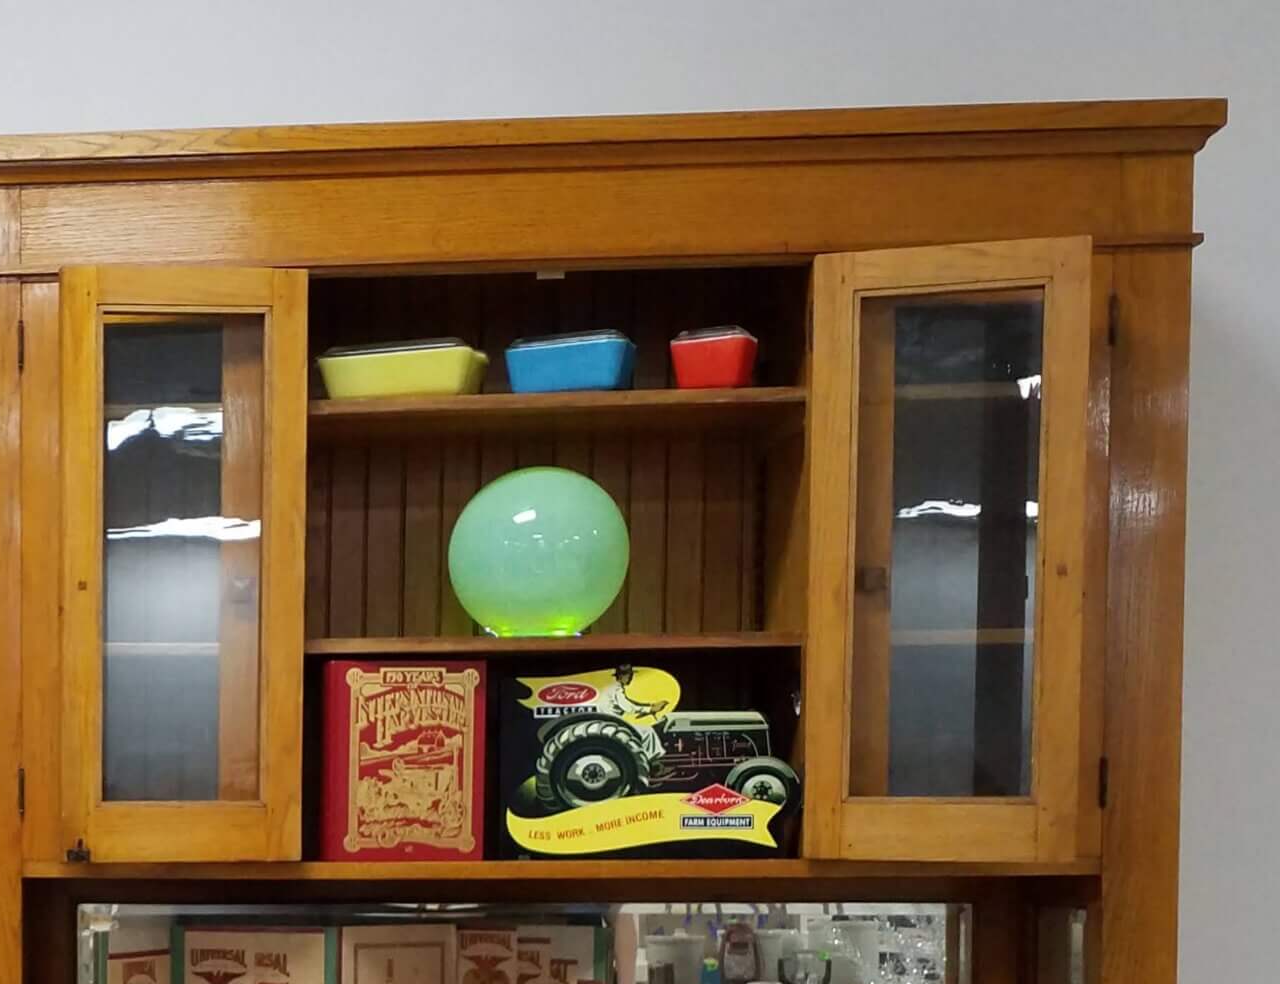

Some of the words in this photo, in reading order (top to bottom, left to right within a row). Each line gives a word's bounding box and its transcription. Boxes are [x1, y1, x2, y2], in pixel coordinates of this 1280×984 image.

[405, 671, 441, 687] YEARS
[545, 686, 589, 700] Ford
[539, 706, 594, 715] TRACTOR
[689, 792, 743, 806] Dearborn
[528, 830, 552, 841] LESS
[595, 820, 622, 833] MORE
[625, 809, 665, 825] INCOME
[684, 817, 705, 827] FARM
[707, 817, 751, 827] EQUIPMENT
